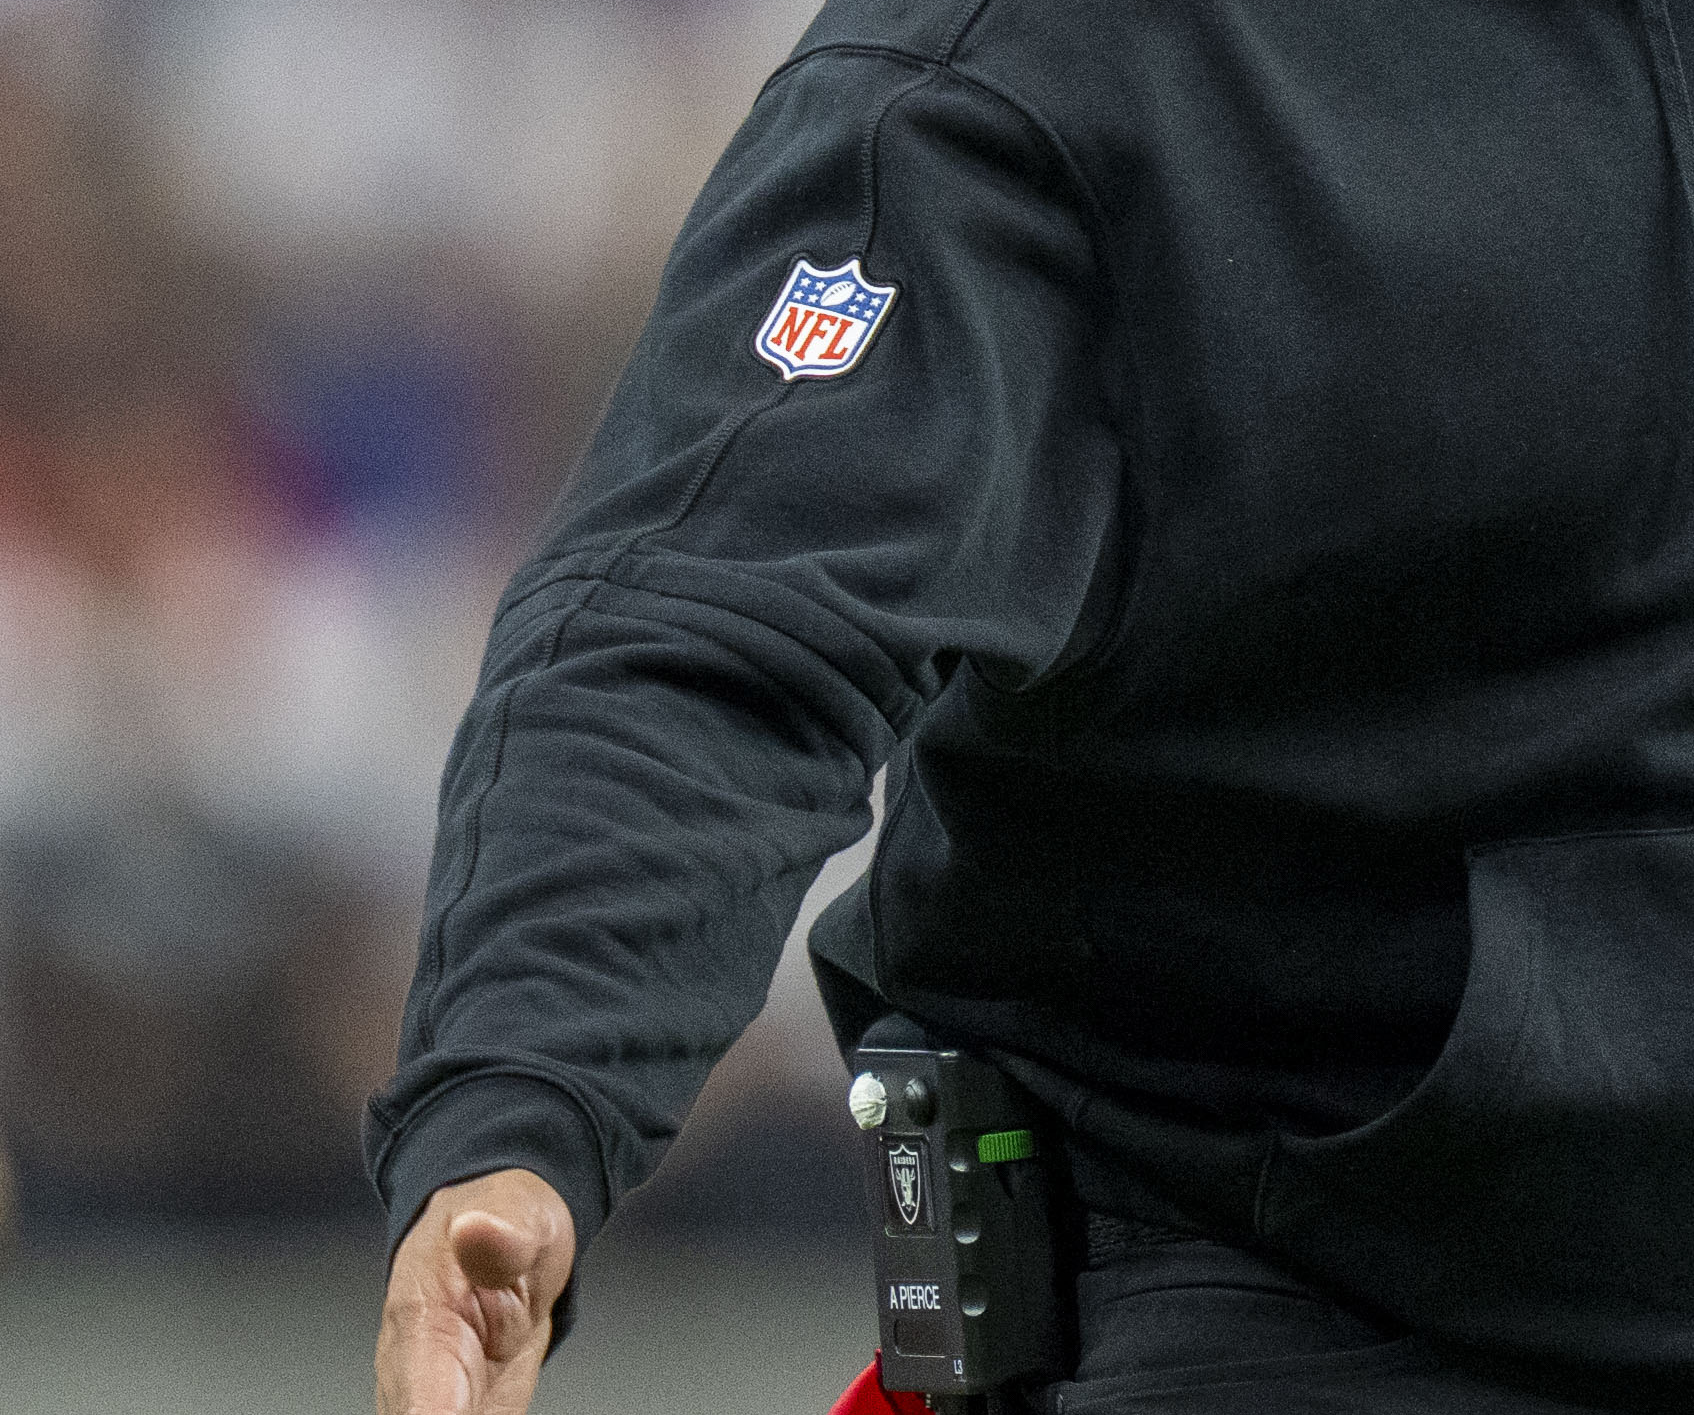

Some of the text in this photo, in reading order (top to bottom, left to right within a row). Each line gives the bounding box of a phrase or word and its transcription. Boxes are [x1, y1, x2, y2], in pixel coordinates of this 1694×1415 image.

[770, 306, 854, 362] NFL
[890, 1285, 942, 1310] A PIERCE
